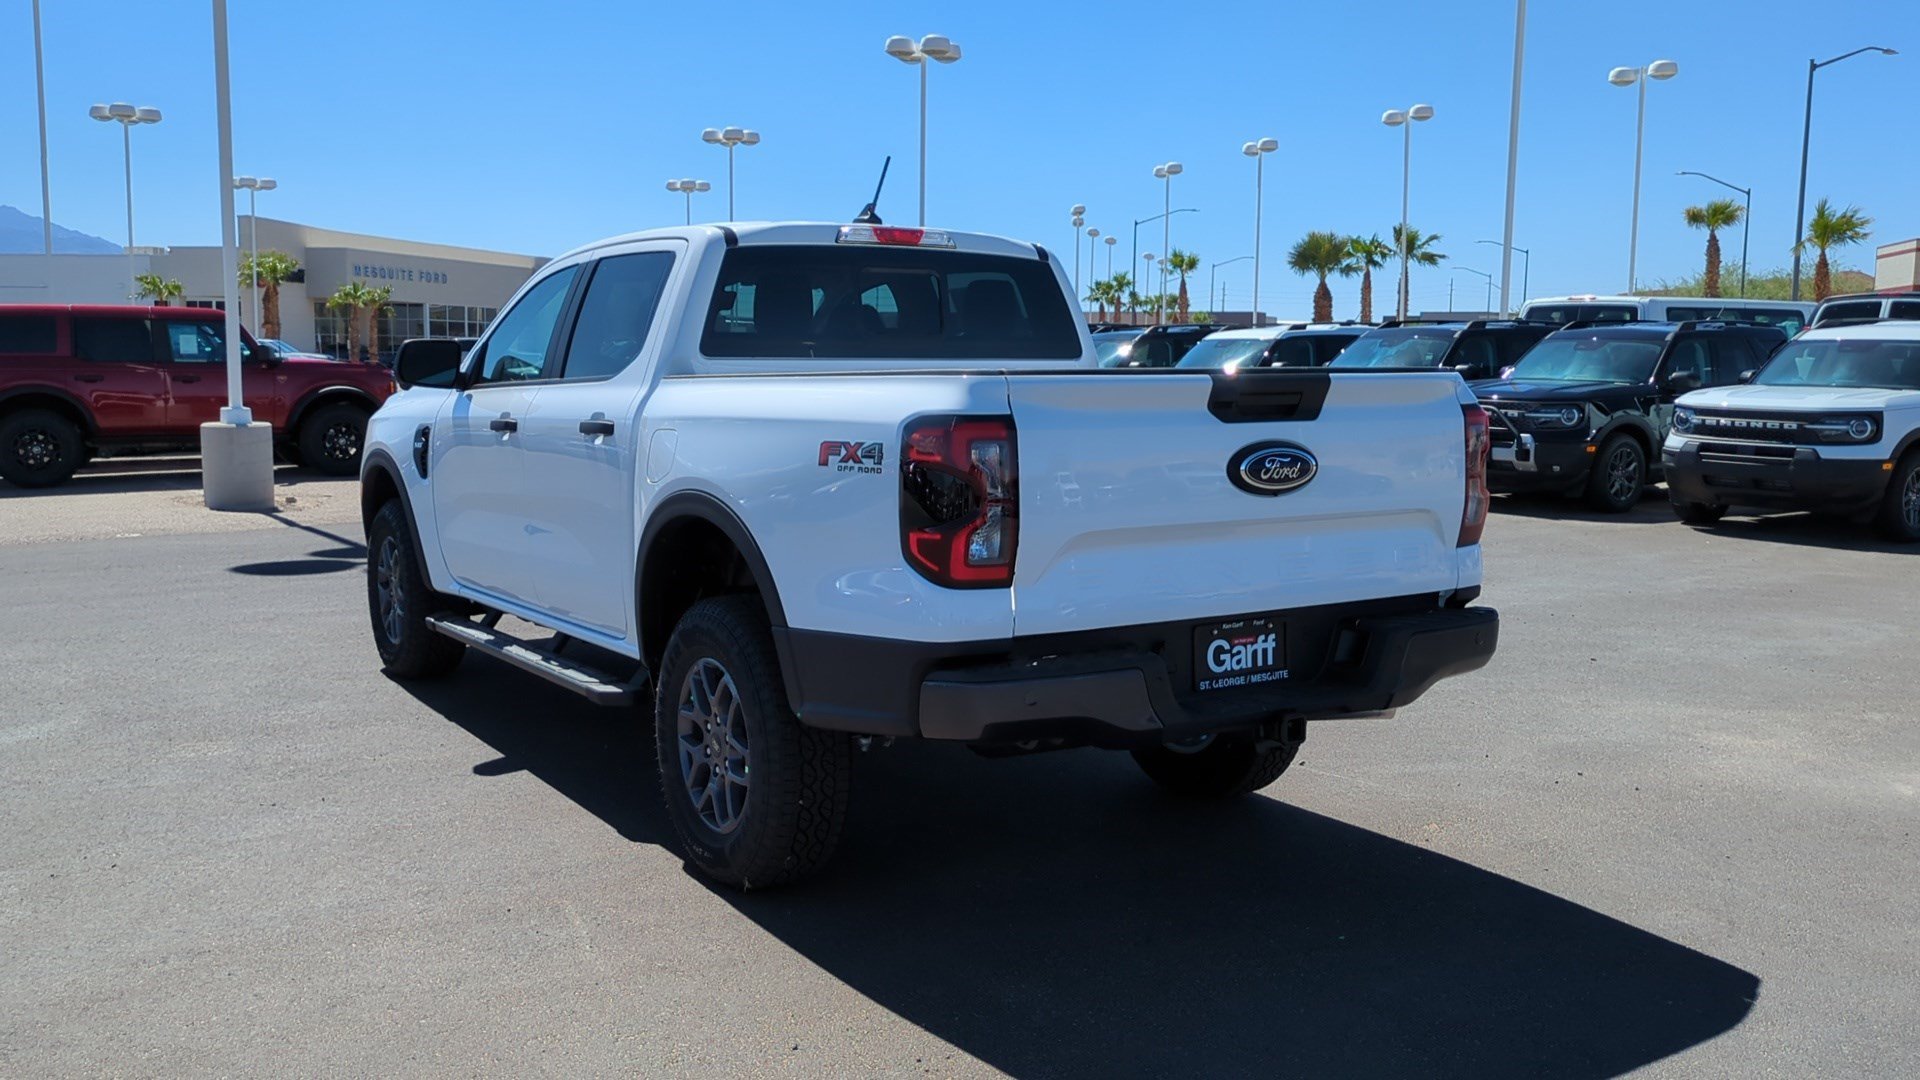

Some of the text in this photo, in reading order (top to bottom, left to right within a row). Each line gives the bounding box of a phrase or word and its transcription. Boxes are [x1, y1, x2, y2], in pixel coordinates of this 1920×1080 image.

[354, 265, 448, 284] MESQUITE FORD
[1704, 419, 1798, 430] BRONCO
[818, 441, 883, 466] FX4
[857, 466, 882, 474] ROAD
[1260, 457, 1301, 479] Ford
[1207, 633, 1276, 673] Garff
[1200, 681, 1211, 690] ST.
[1212, 677, 1246, 688] GEORGE
[1251, 669, 1289, 683] MESQUITE
